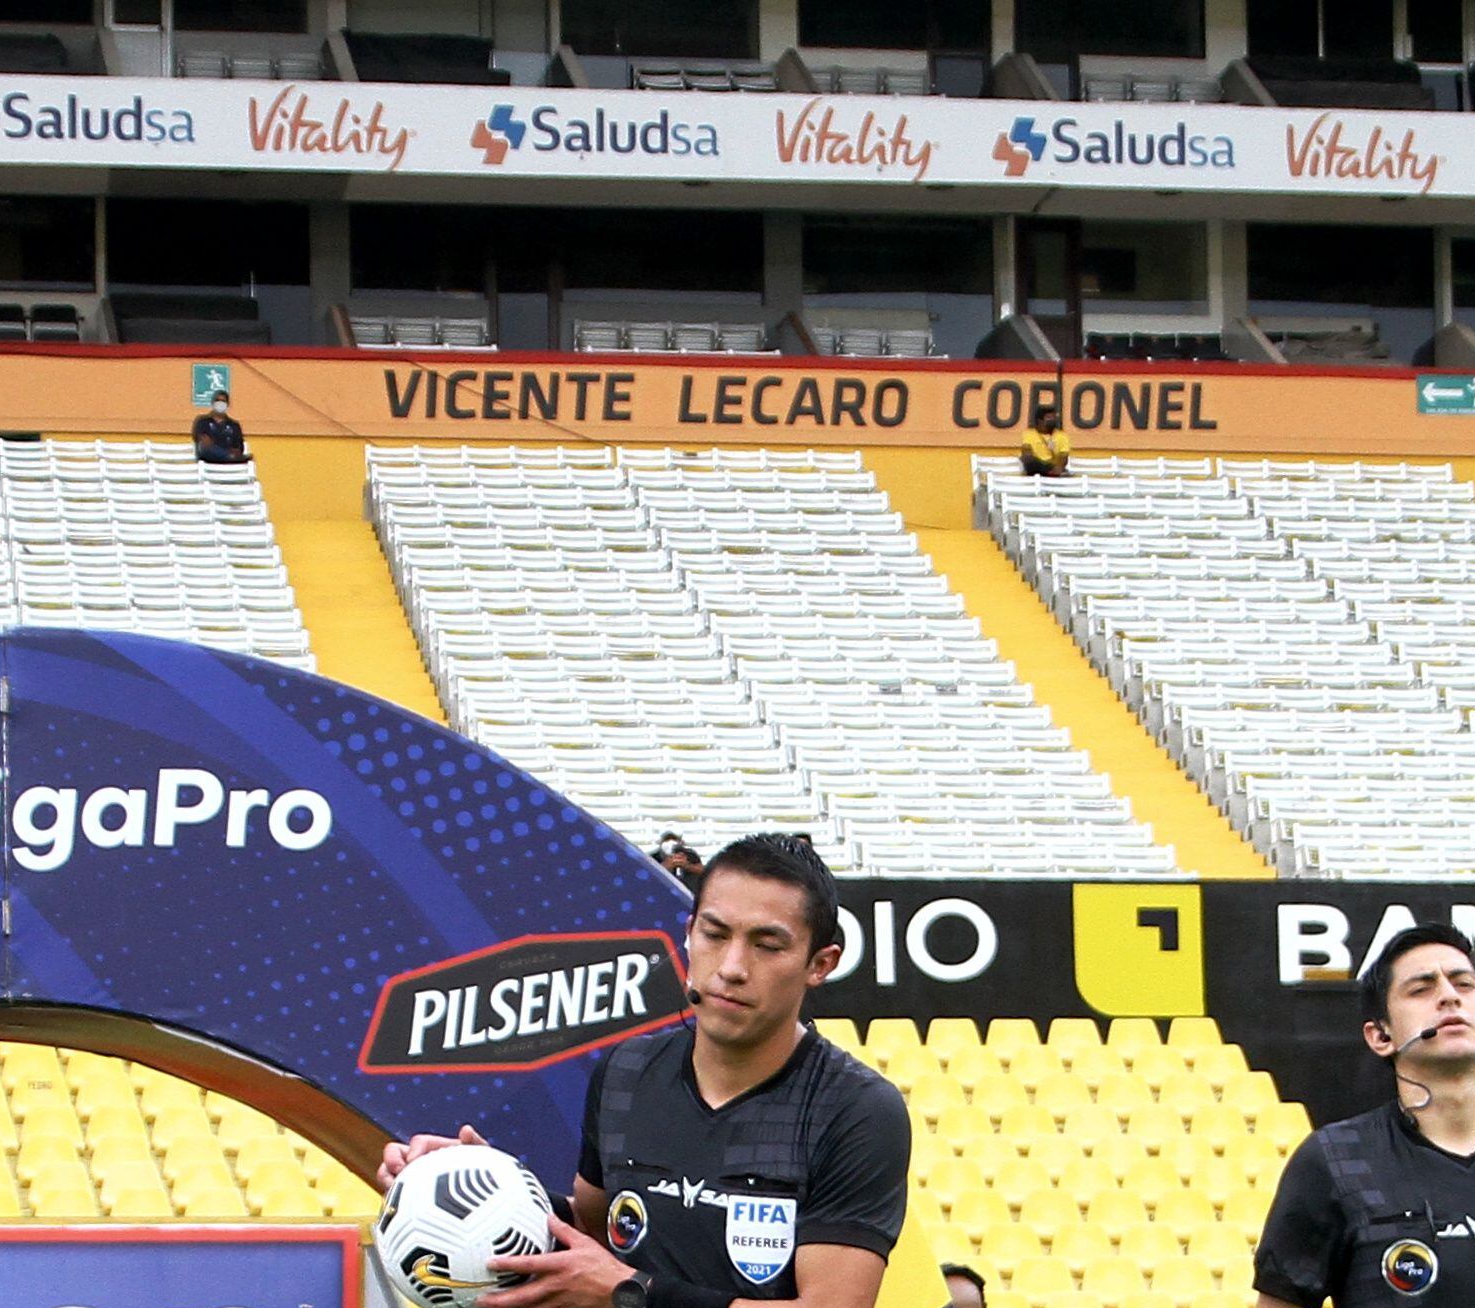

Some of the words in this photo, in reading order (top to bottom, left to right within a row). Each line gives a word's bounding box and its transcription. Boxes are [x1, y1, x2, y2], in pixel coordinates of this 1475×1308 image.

[2, 92, 195, 143] Saludsa
[248, 86, 408, 171] Vitality
[531, 106, 720, 158] Saludsa
[775, 98, 932, 181] Vitality
[1051, 119, 1236, 168] Saludsa
[1286, 113, 1440, 192] Vitality
[384, 369, 634, 423] VICENTE
[678, 376, 909, 428] LECARO
[952, 378, 1217, 431] CORONEL
[407, 953, 649, 1056] PILSENER
[733, 1201, 788, 1225] FIFA
[732, 1236, 787, 1250] REFEREE
[745, 1263, 772, 1276] 2021
